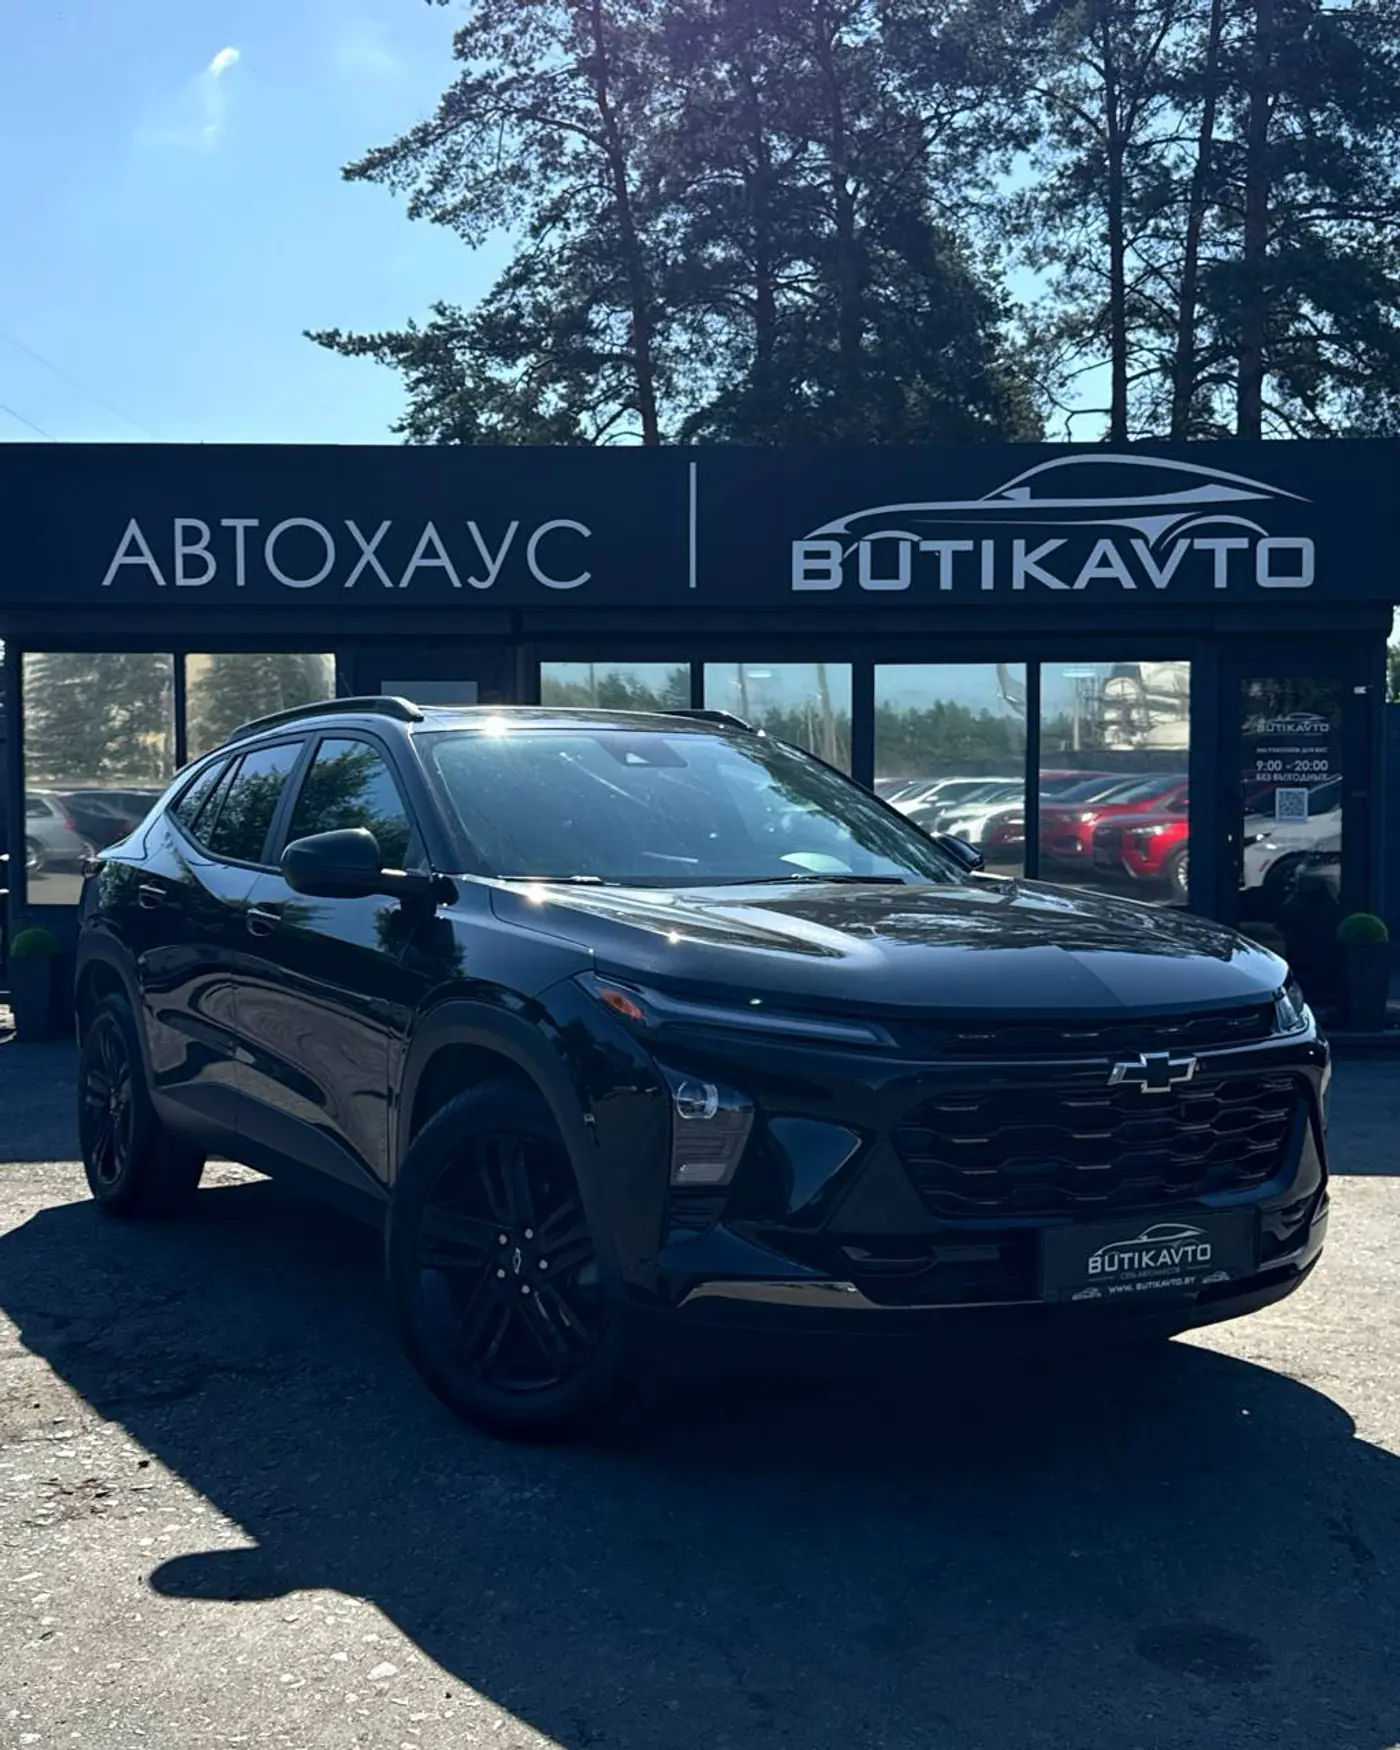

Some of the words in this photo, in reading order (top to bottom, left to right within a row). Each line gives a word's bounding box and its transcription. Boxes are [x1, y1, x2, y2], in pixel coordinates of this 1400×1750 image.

[102, 517, 592, 589] АВТОХАУС
[792, 537, 1315, 590] BUTIKAVTO
[1257, 723, 1329, 732] BUTIKAVTO
[1256, 760, 1282, 771] 9:00
[1294, 760, 1329, 771] 20:00
[1088, 1244, 1211, 1274] BUTIKAVTO
